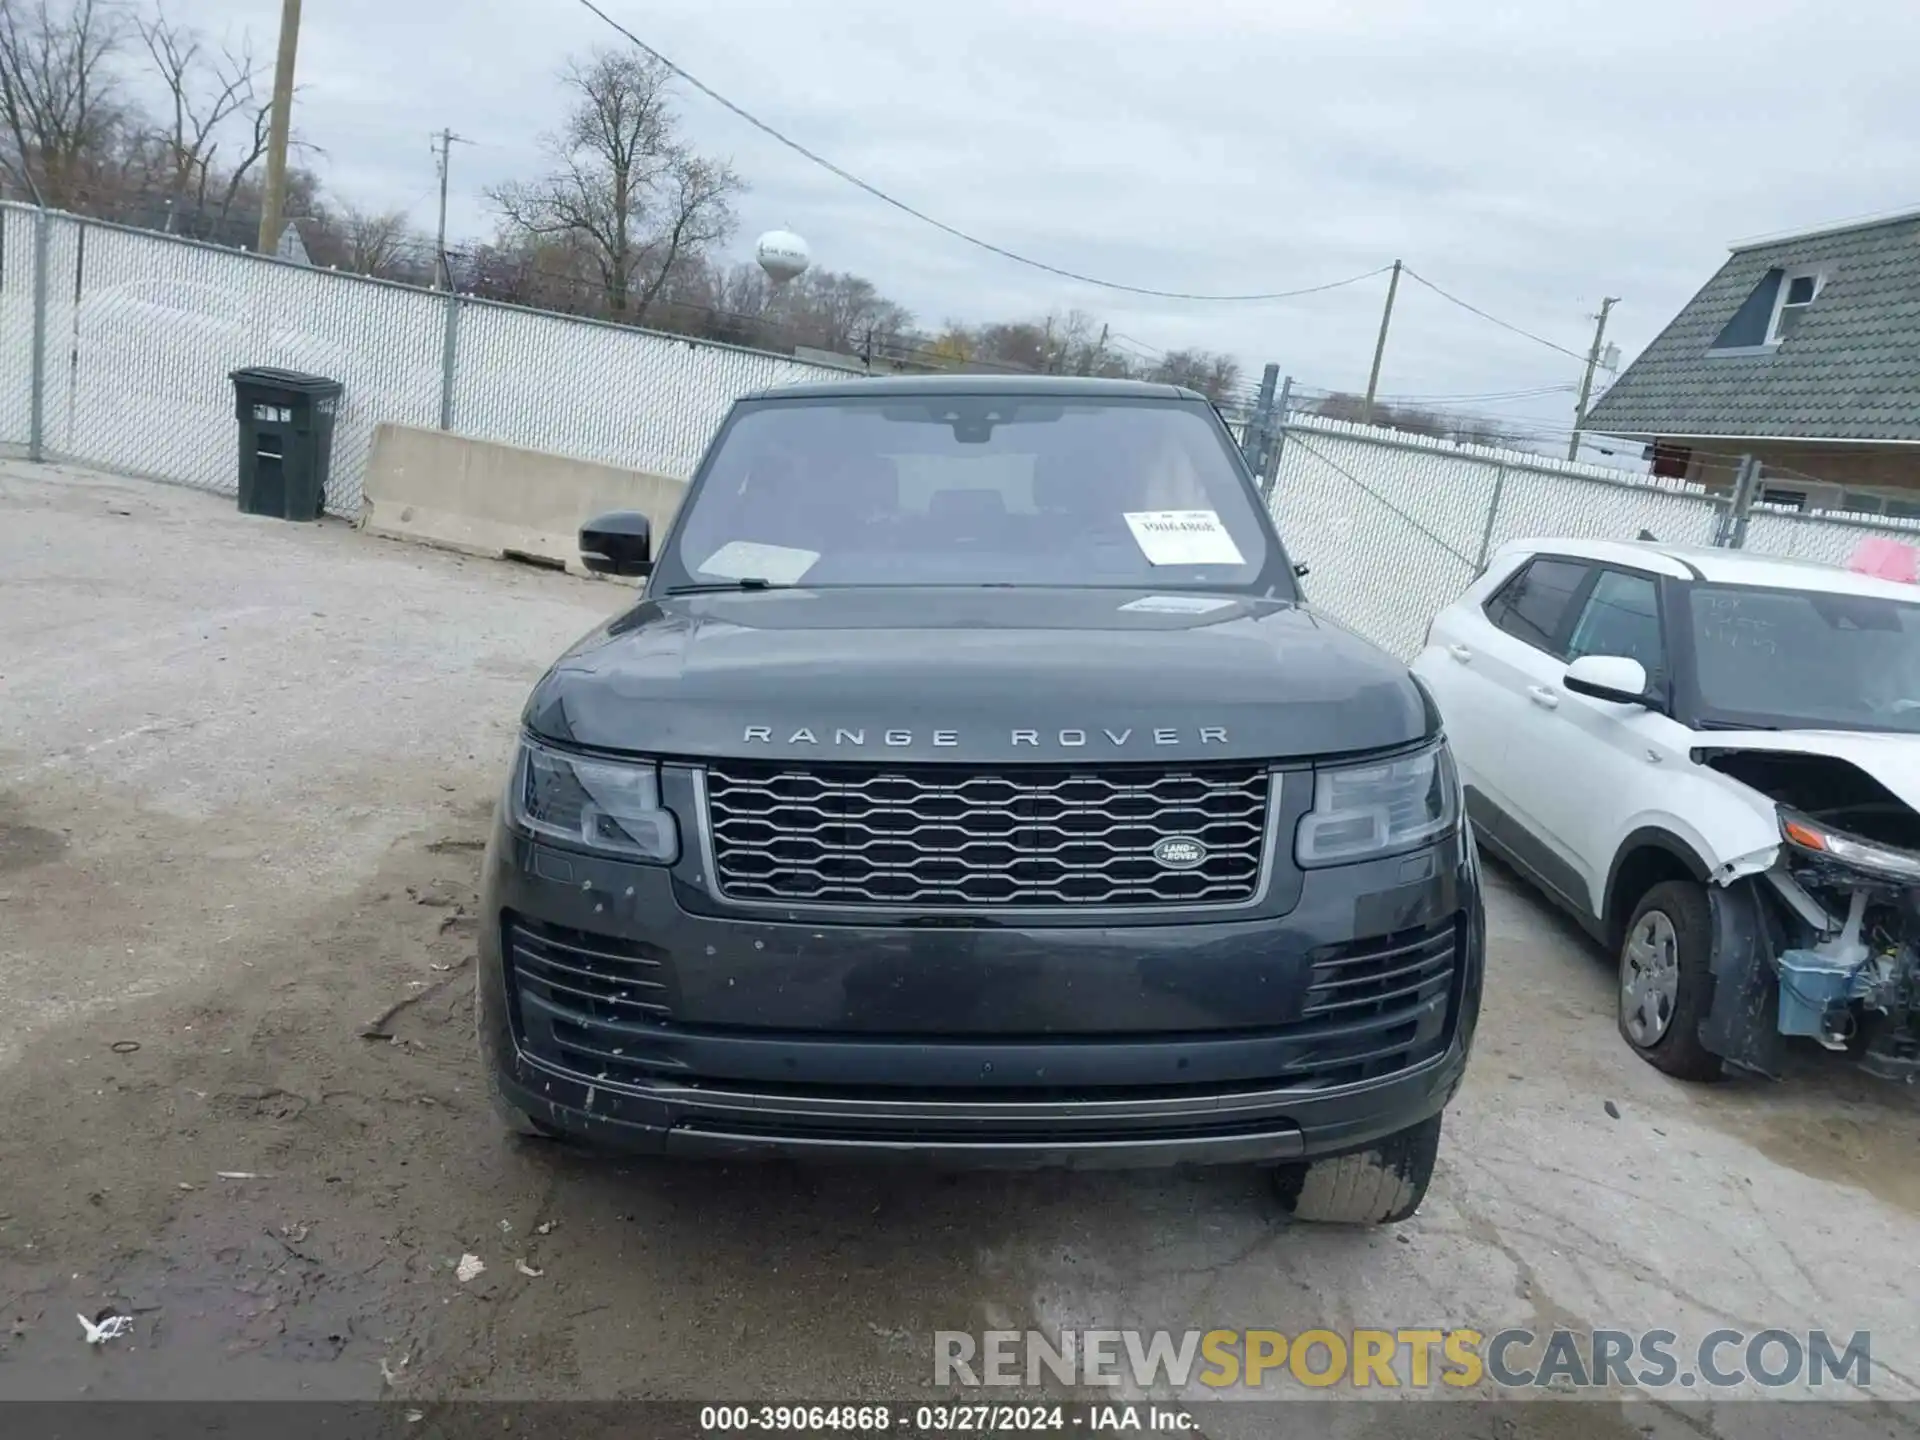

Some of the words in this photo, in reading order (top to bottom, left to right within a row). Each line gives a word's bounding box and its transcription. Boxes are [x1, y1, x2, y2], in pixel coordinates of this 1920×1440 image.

[744, 726, 958, 747] RANGE
[1011, 726, 1229, 747] ROVER
[1163, 844, 1190, 852] LAND
[1167, 851, 1198, 860] ROVER
